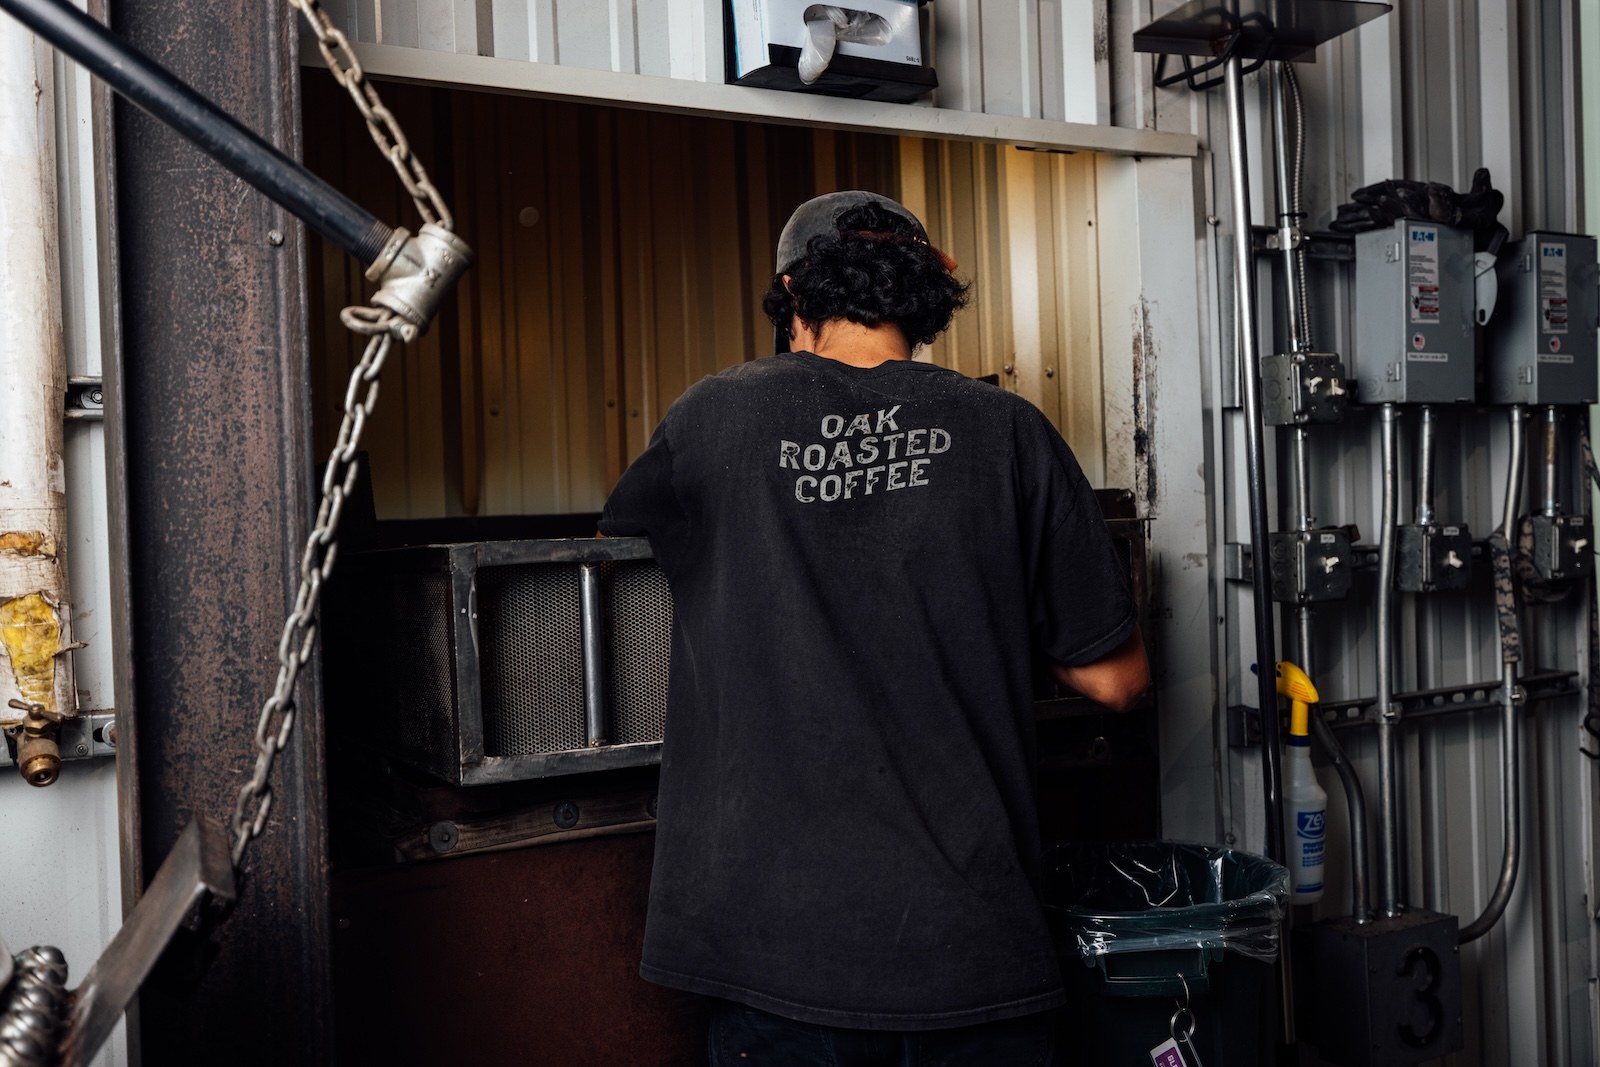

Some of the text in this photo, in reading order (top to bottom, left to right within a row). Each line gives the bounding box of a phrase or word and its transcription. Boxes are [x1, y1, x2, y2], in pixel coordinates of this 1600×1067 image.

[821, 404, 902, 439] OAK
[779, 428, 952, 471] ROASTED
[794, 458, 931, 503] COFFEE
[1396, 946, 1443, 1049] 3
